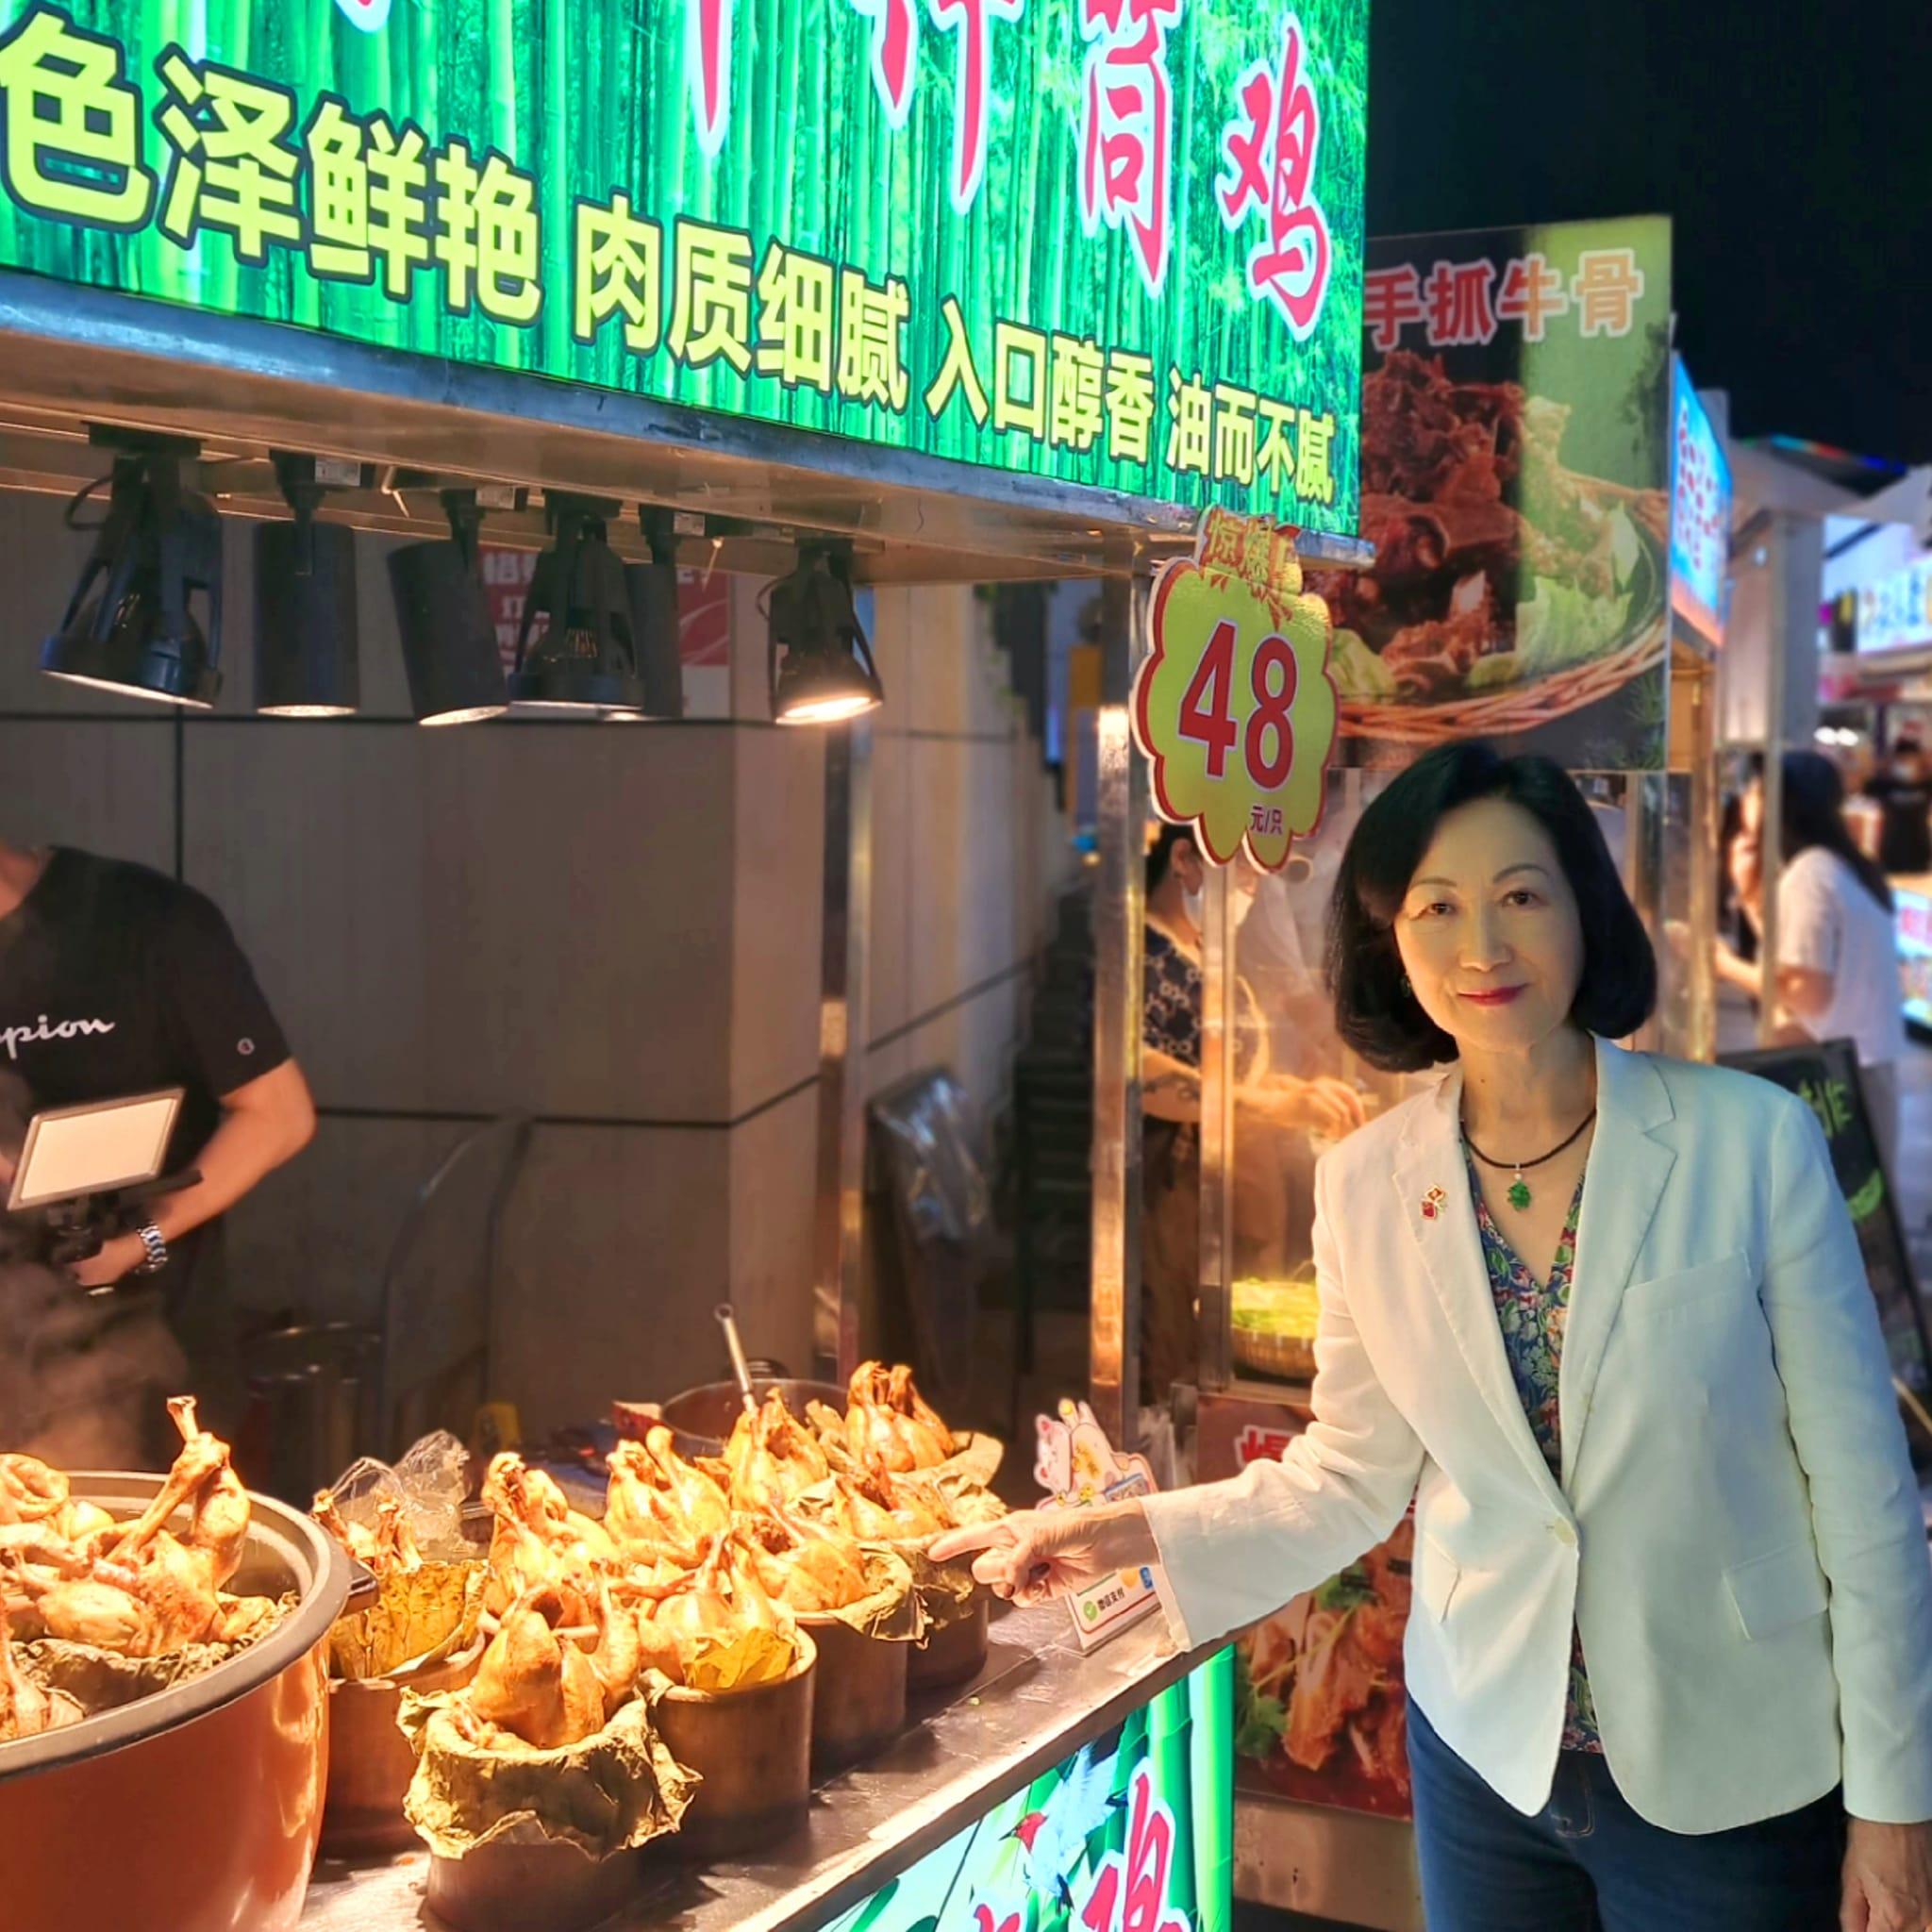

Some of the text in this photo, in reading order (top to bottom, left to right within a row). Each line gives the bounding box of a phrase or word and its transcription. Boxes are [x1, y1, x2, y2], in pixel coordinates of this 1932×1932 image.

[0, 8, 1336, 503] 色泽鲜艳 肉质细腻 入口醇香 油而不腻
[1364, 248, 1643, 351] 手抓牛骨
[1178, 619, 1298, 792] 48
[1249, 806, 1284, 835] 元/只
[0, 1014, 115, 1059] pion
